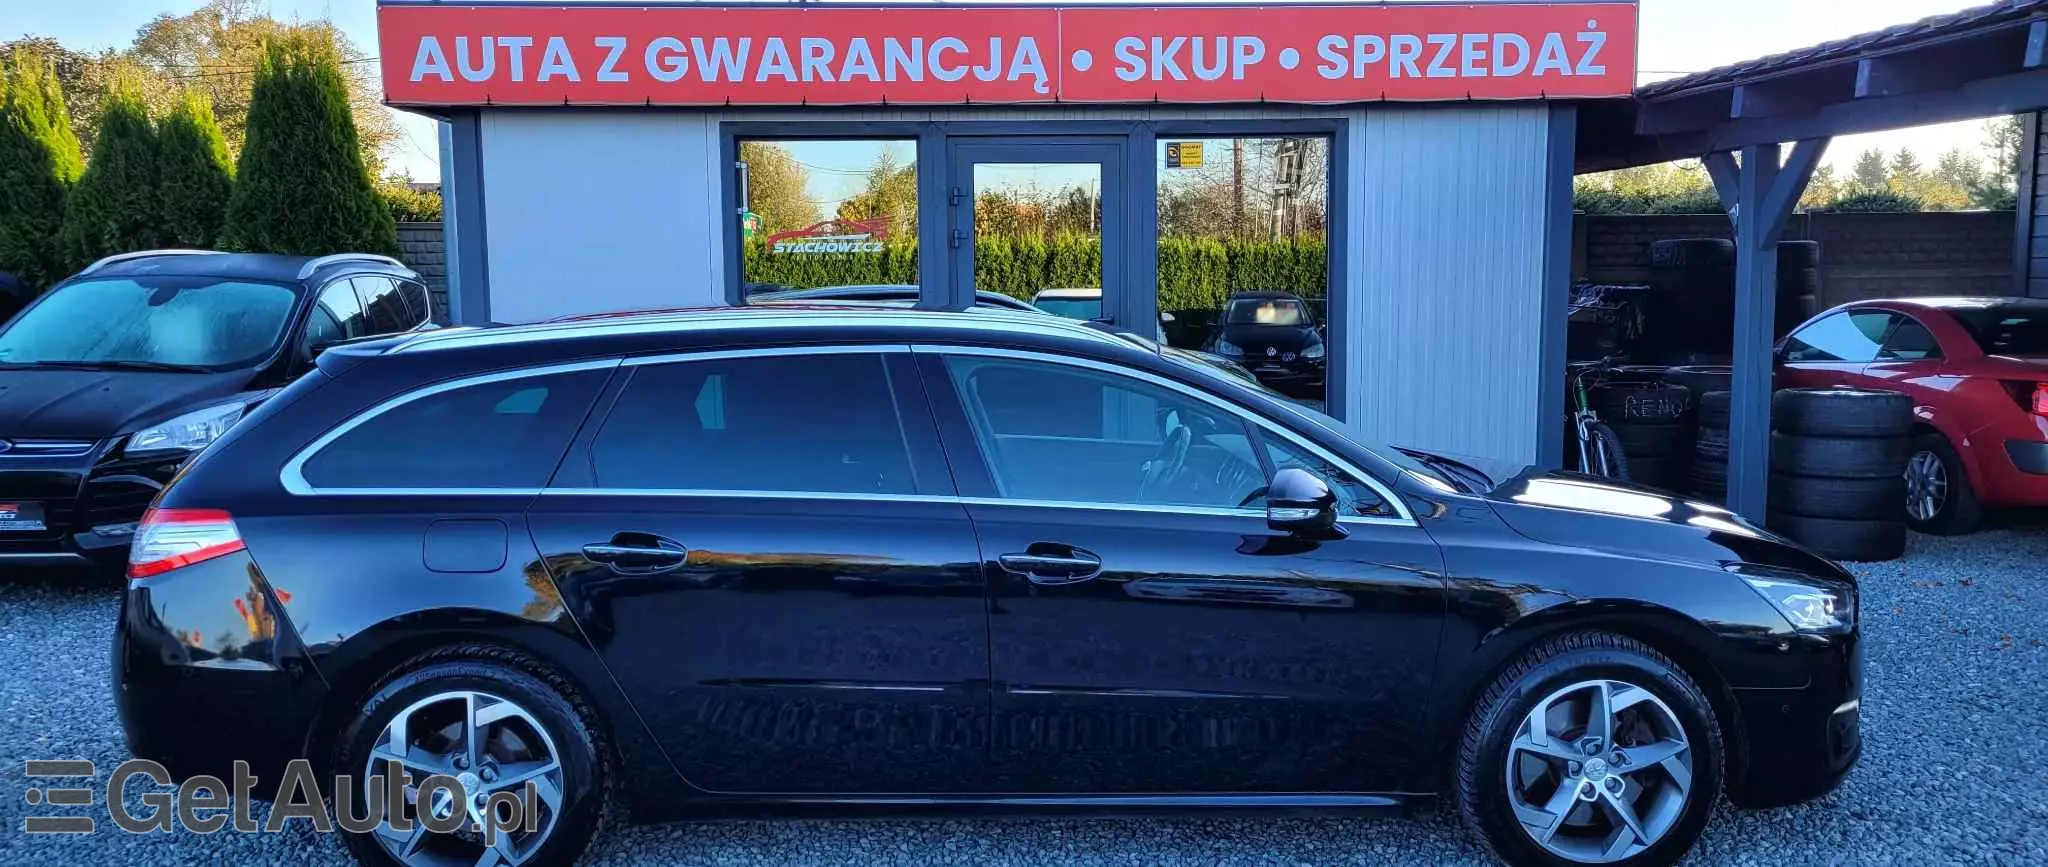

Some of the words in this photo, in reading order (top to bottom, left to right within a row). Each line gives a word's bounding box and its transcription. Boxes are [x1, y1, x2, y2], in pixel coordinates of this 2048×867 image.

[409, 36, 581, 82] AUTA
[594, 36, 629, 82] Z
[644, 36, 1050, 94] GWARANCJĄ
[1114, 36, 1266, 82] SKUP
[1316, 19, 1607, 80] SPRZEDAŻ
